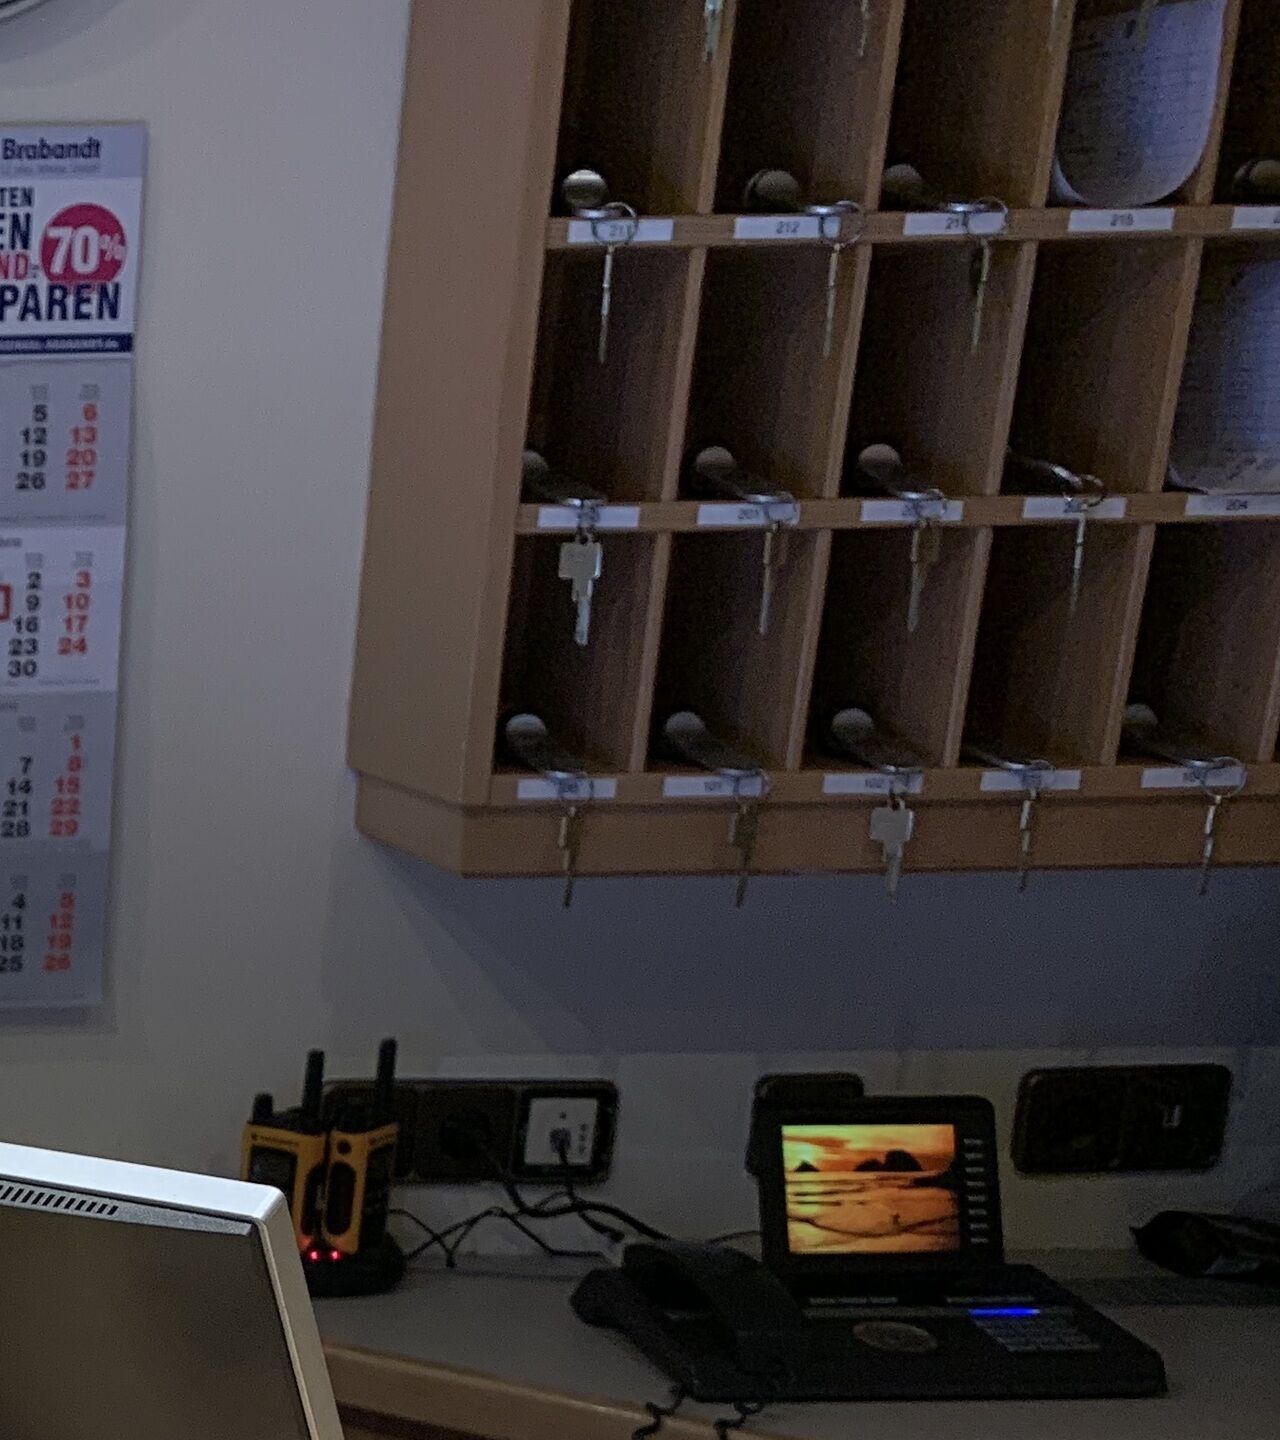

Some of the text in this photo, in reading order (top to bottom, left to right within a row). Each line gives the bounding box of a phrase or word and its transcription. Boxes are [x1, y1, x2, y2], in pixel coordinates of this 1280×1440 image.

[2, 136, 101, 160] Brabandt
[46, 226, 123, 275] 70%
[34, 404, 48, 422] 5
[22, 426, 46, 446] 12
[72, 426, 98, 446] 13
[22, 448, 46, 468] 19
[66, 448, 96, 468] 20
[16, 472, 46, 490] 26
[66, 470, 94, 490] 27
[26, 572, 42, 590] 2
[76, 570, 90, 590] 3
[26, 594, 40, 612] 9
[64, 592, 90, 612] 10
[14, 616, 40, 634] 16
[64, 614, 88, 634] 17
[8, 638, 38, 656] 23
[58, 636, 88, 656] 24
[8, 660, 38, 678] 30
[70, 734, 80, 750] 1
[20, 756, 32, 774] 7
[8, 778, 32, 796] 14
[56, 776, 80, 794] 15
[2, 800, 28, 818] 21
[52, 798, 80, 816] 22
[0, 820, 30, 838] 28
[50, 818, 78, 836] 29
[12, 894, 26, 910] 4
[2, 914, 22, 930] 11
[0, 934, 24, 952] 18
